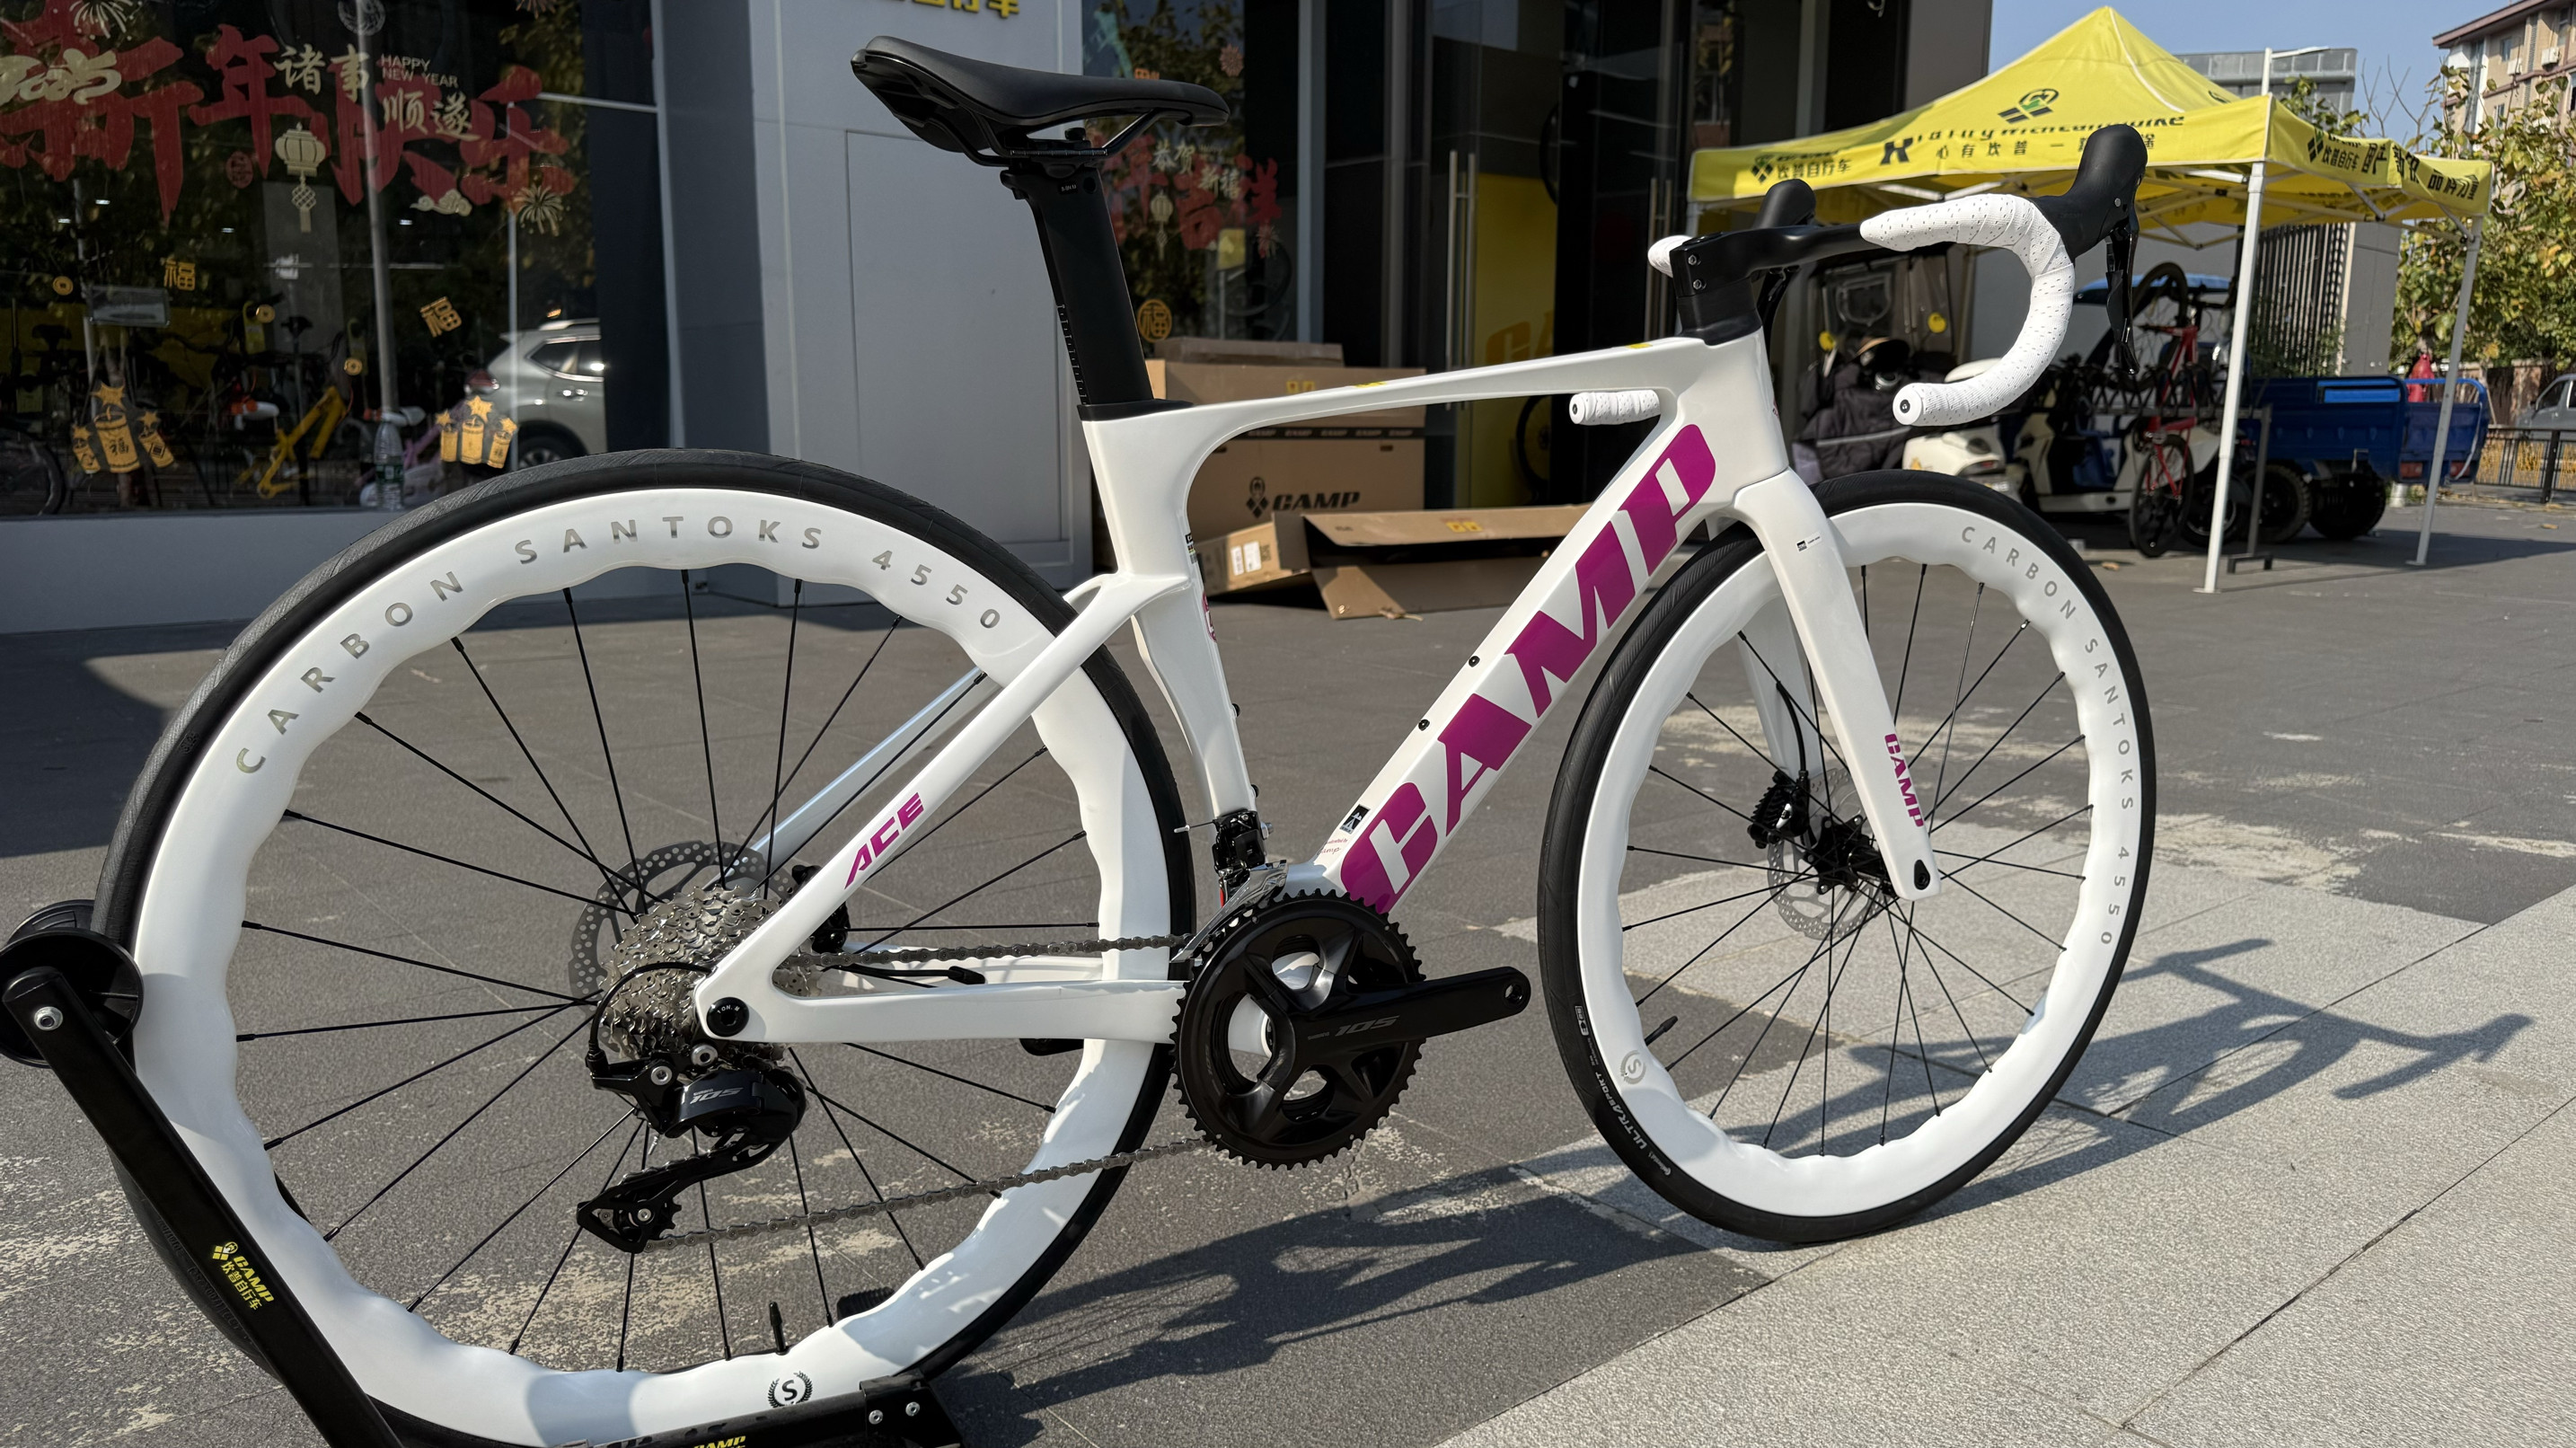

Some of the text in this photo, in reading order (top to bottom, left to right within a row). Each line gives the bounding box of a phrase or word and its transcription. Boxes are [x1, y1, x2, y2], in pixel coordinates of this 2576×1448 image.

[273, 44, 369, 103] 诸事
[381, 54, 430, 72] HAPPY
[382, 67, 459, 89] NEW YEAR
[163, 259, 196, 291] 福
[420, 296, 463, 338] 福
[1141, 305, 1169, 339] 福
[1272, 491, 1361, 512] CAMP
[1961, 525, 2077, 620] CARBON
[235, 516, 1001, 774] CARBON SANTOKS 4550
[1341, 423, 1716, 914] CAMP
[2084, 638, 2134, 809] SANTOKS
[1883, 733, 1925, 828] CAMP
[844, 792, 925, 890] ACE
[2100, 846, 2130, 945] 4550
[1335, 1015, 1401, 1037] 105
[689, 1087, 745, 1105] 105
[221, 1260, 263, 1311] 坎普自行车
[234, 1256, 275, 1302] CAMP
